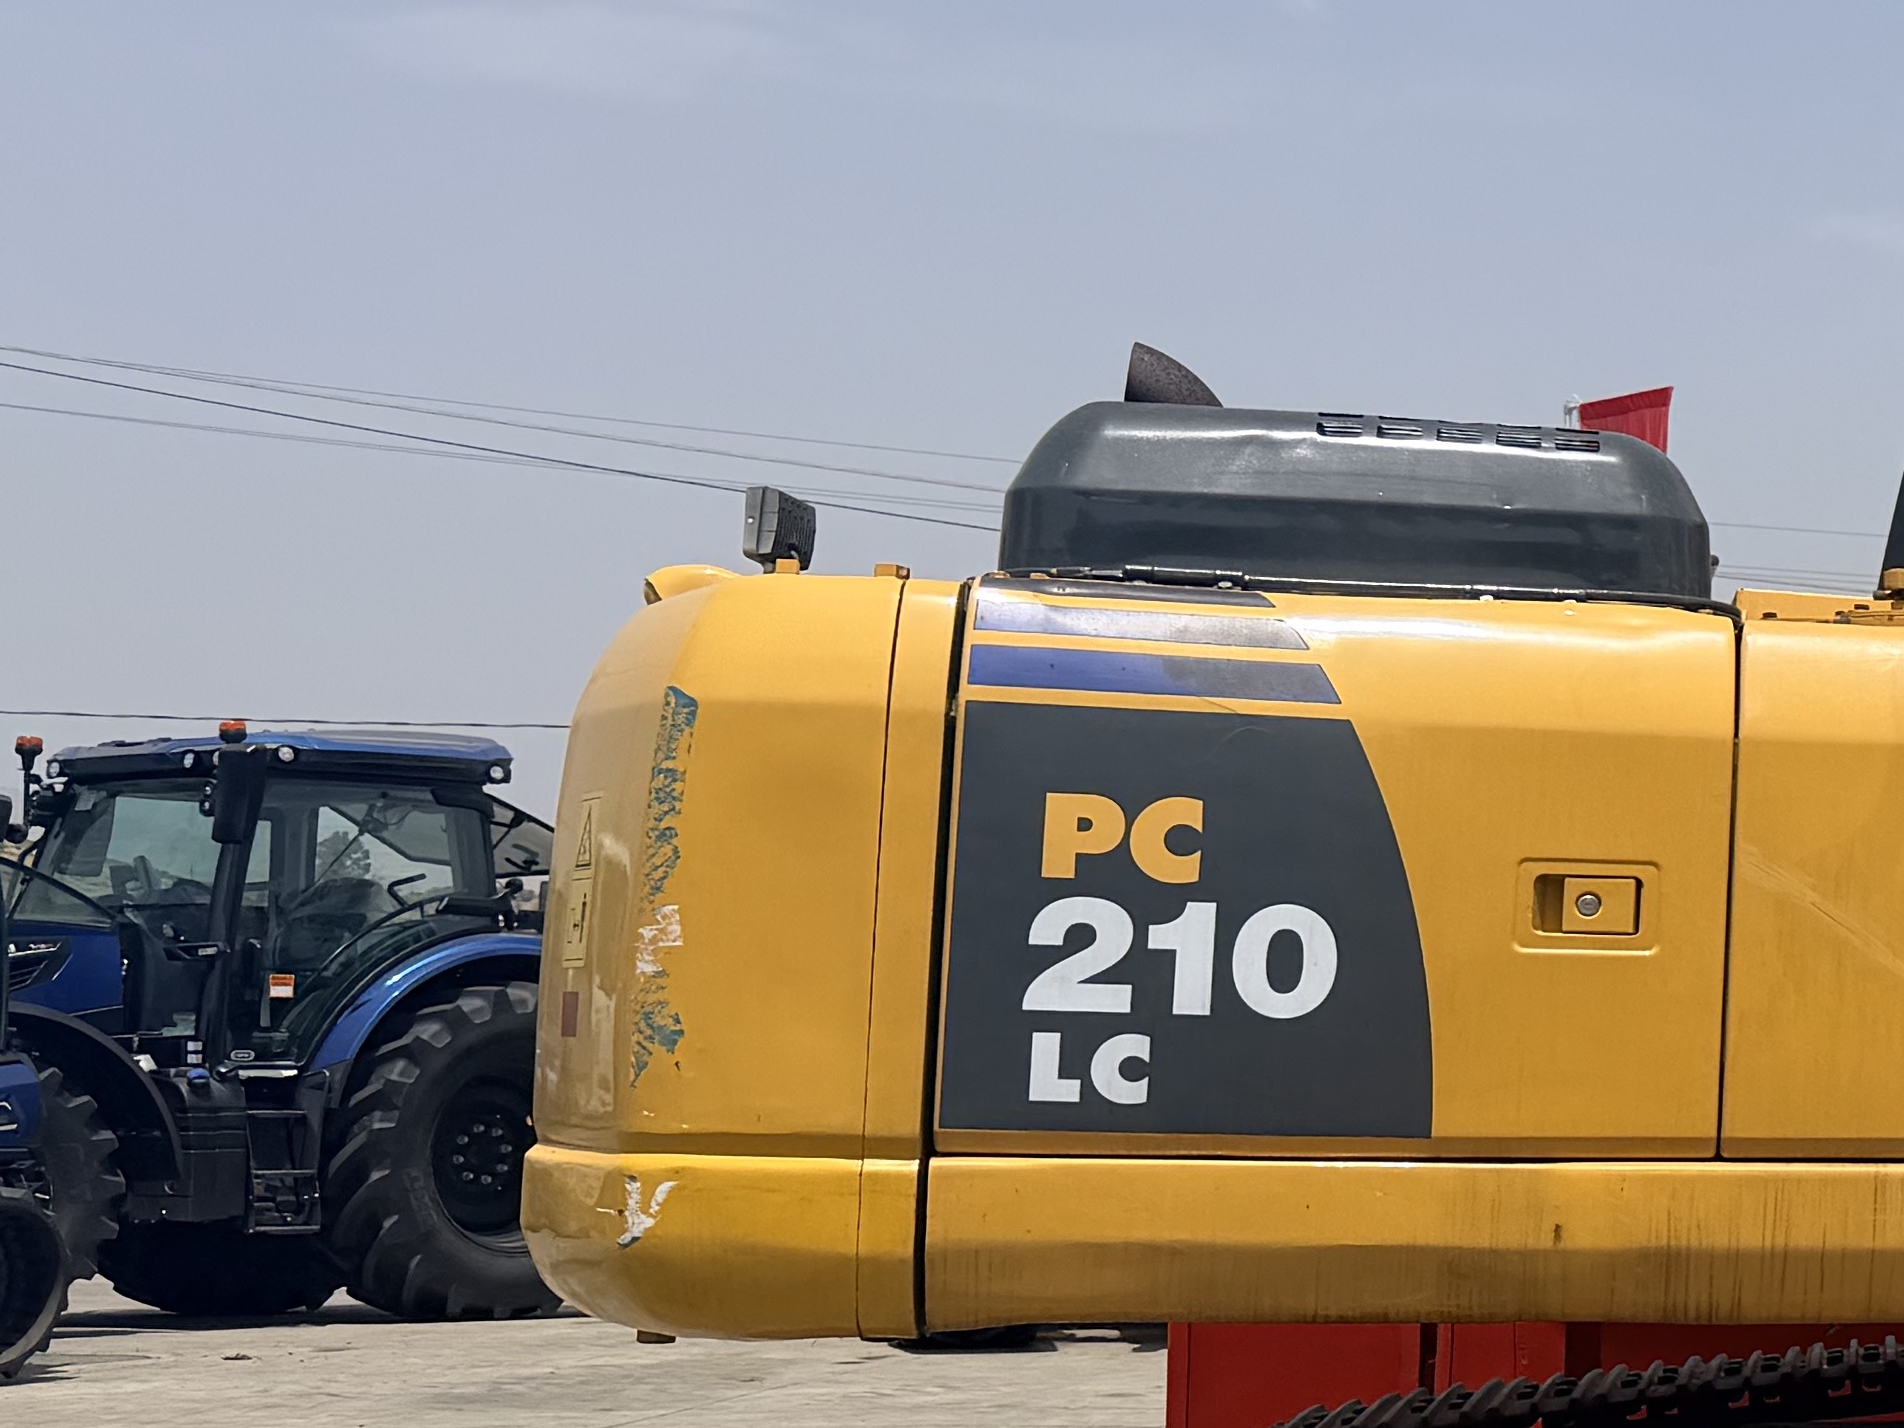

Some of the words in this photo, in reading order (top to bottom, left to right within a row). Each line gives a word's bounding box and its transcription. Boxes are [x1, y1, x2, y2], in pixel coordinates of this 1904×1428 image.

[1041, 792, 1204, 884] PC
[1021, 896, 1338, 1019] 210
[1028, 1031, 1151, 1105] LC
